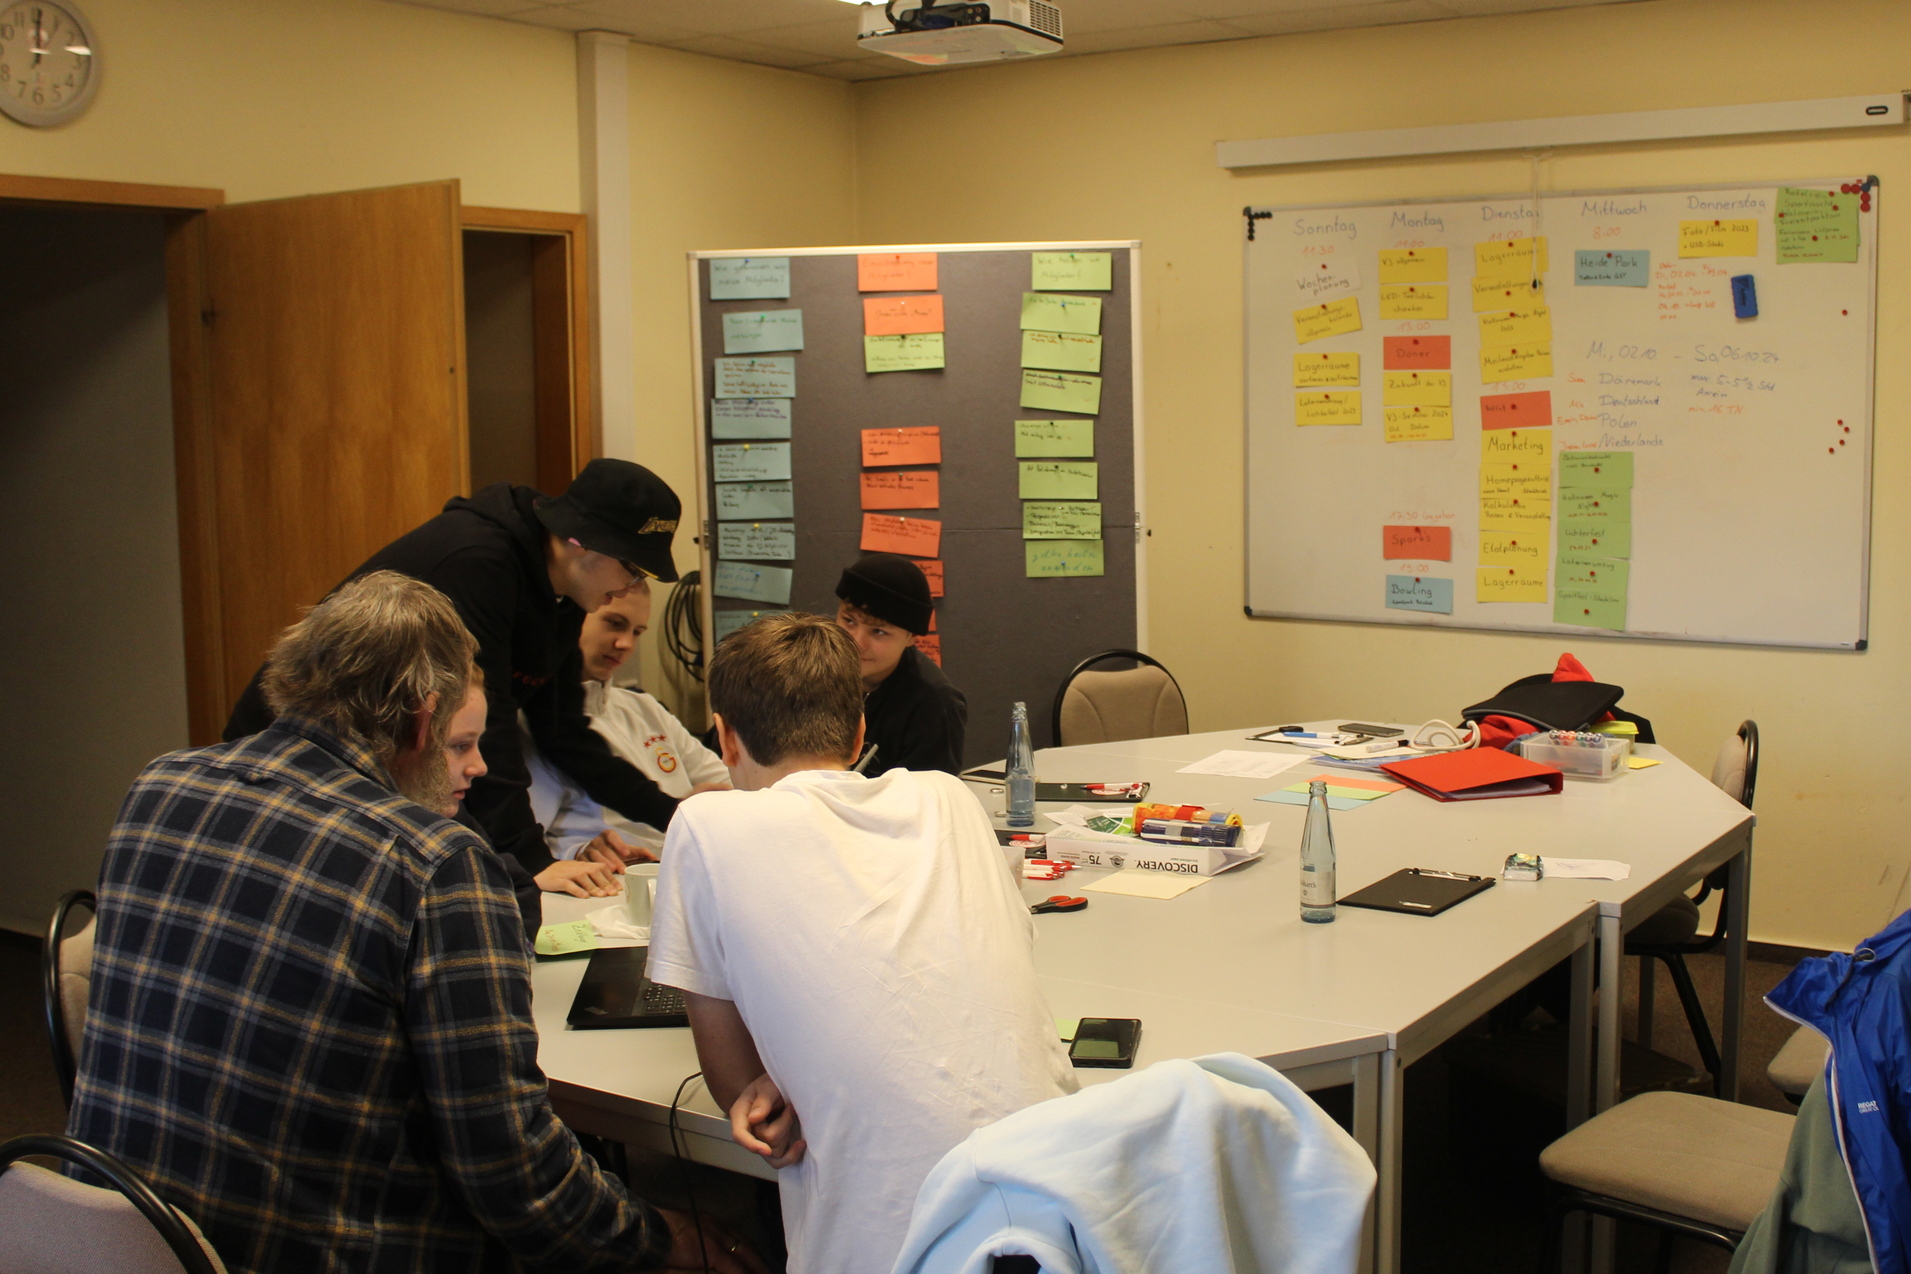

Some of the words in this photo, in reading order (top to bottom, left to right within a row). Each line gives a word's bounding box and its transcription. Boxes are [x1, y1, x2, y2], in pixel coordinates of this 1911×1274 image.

[17, 81, 27, 99] 7
[32, 86, 45, 105] 6
[1581, 199, 1648, 217] Mittwoch
[1687, 194, 1766, 213] Donnerstag
[1391, 211, 1445, 233] Montag
[1481, 204, 1540, 222] Diensta
[1293, 215, 1358, 240] Sonntag
[1580, 256, 1608, 268] Heide
[1615, 255, 1638, 268] Park
[1597, 413, 1637, 428] Polen
[1487, 434, 1544, 456] Marketing
[1598, 433, 1664, 449] Niederlande
[1391, 582, 1433, 599] Bowling
[1088, 854, 1102, 866] 75
[1136, 860, 1199, 874] DISCOVERY
